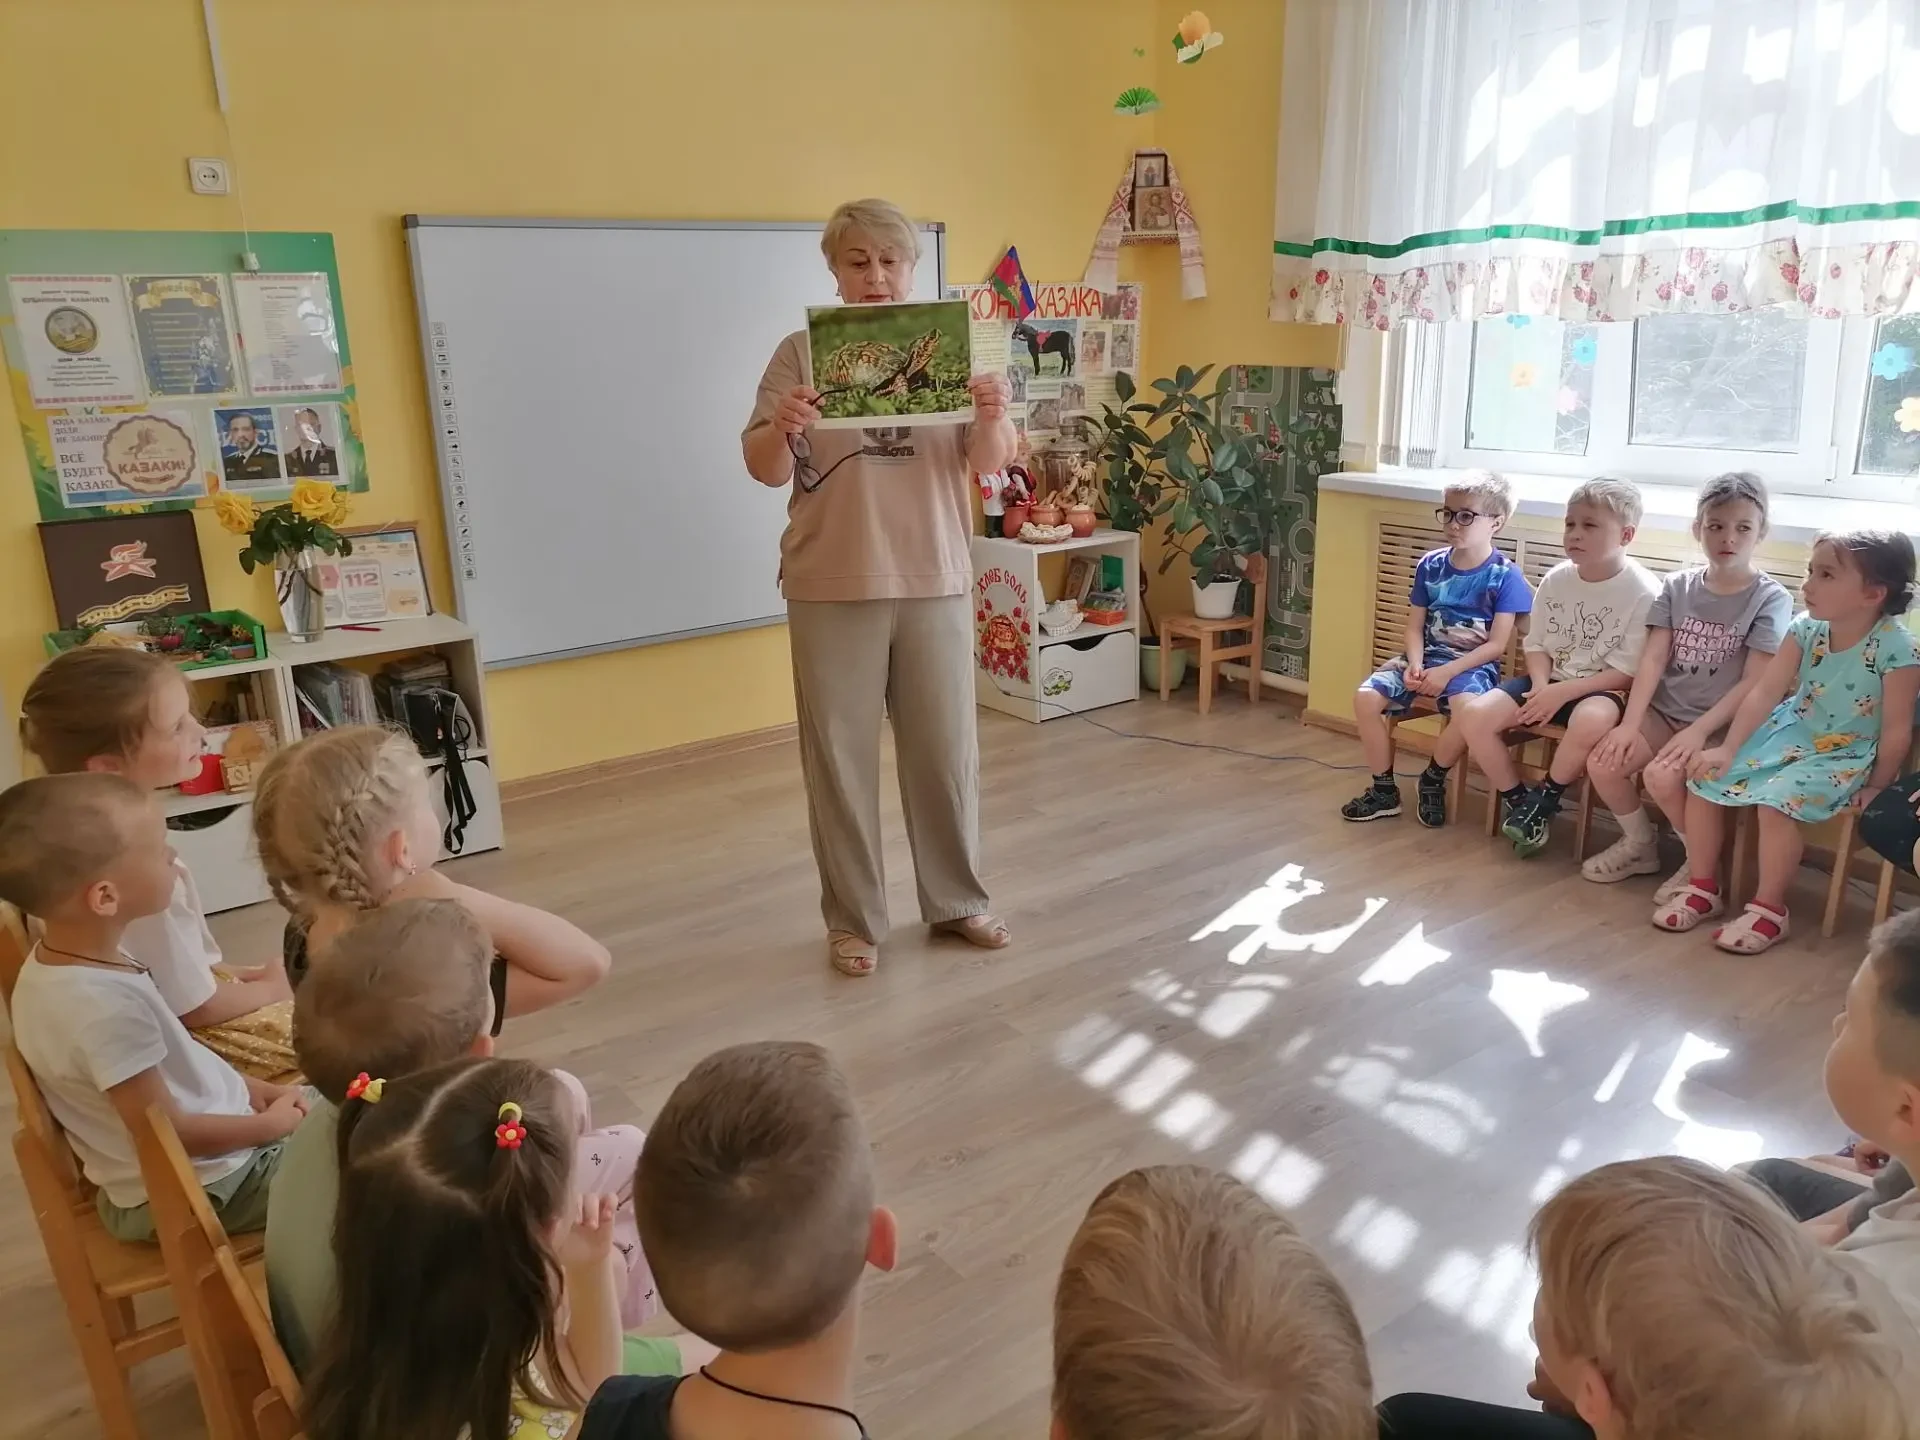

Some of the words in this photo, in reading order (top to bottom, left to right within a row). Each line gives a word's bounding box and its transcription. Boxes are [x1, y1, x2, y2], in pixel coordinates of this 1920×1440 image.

[1034, 286, 1102, 319] КАЗАКА
[63, 466, 105, 478] БУДЕТ
[118, 459, 186, 475] КАЗАКИ!
[65, 480, 114, 492] КАЗАК!
[345, 572, 379, 588] 112
[1004, 570, 1027, 603] СОЛЬ
